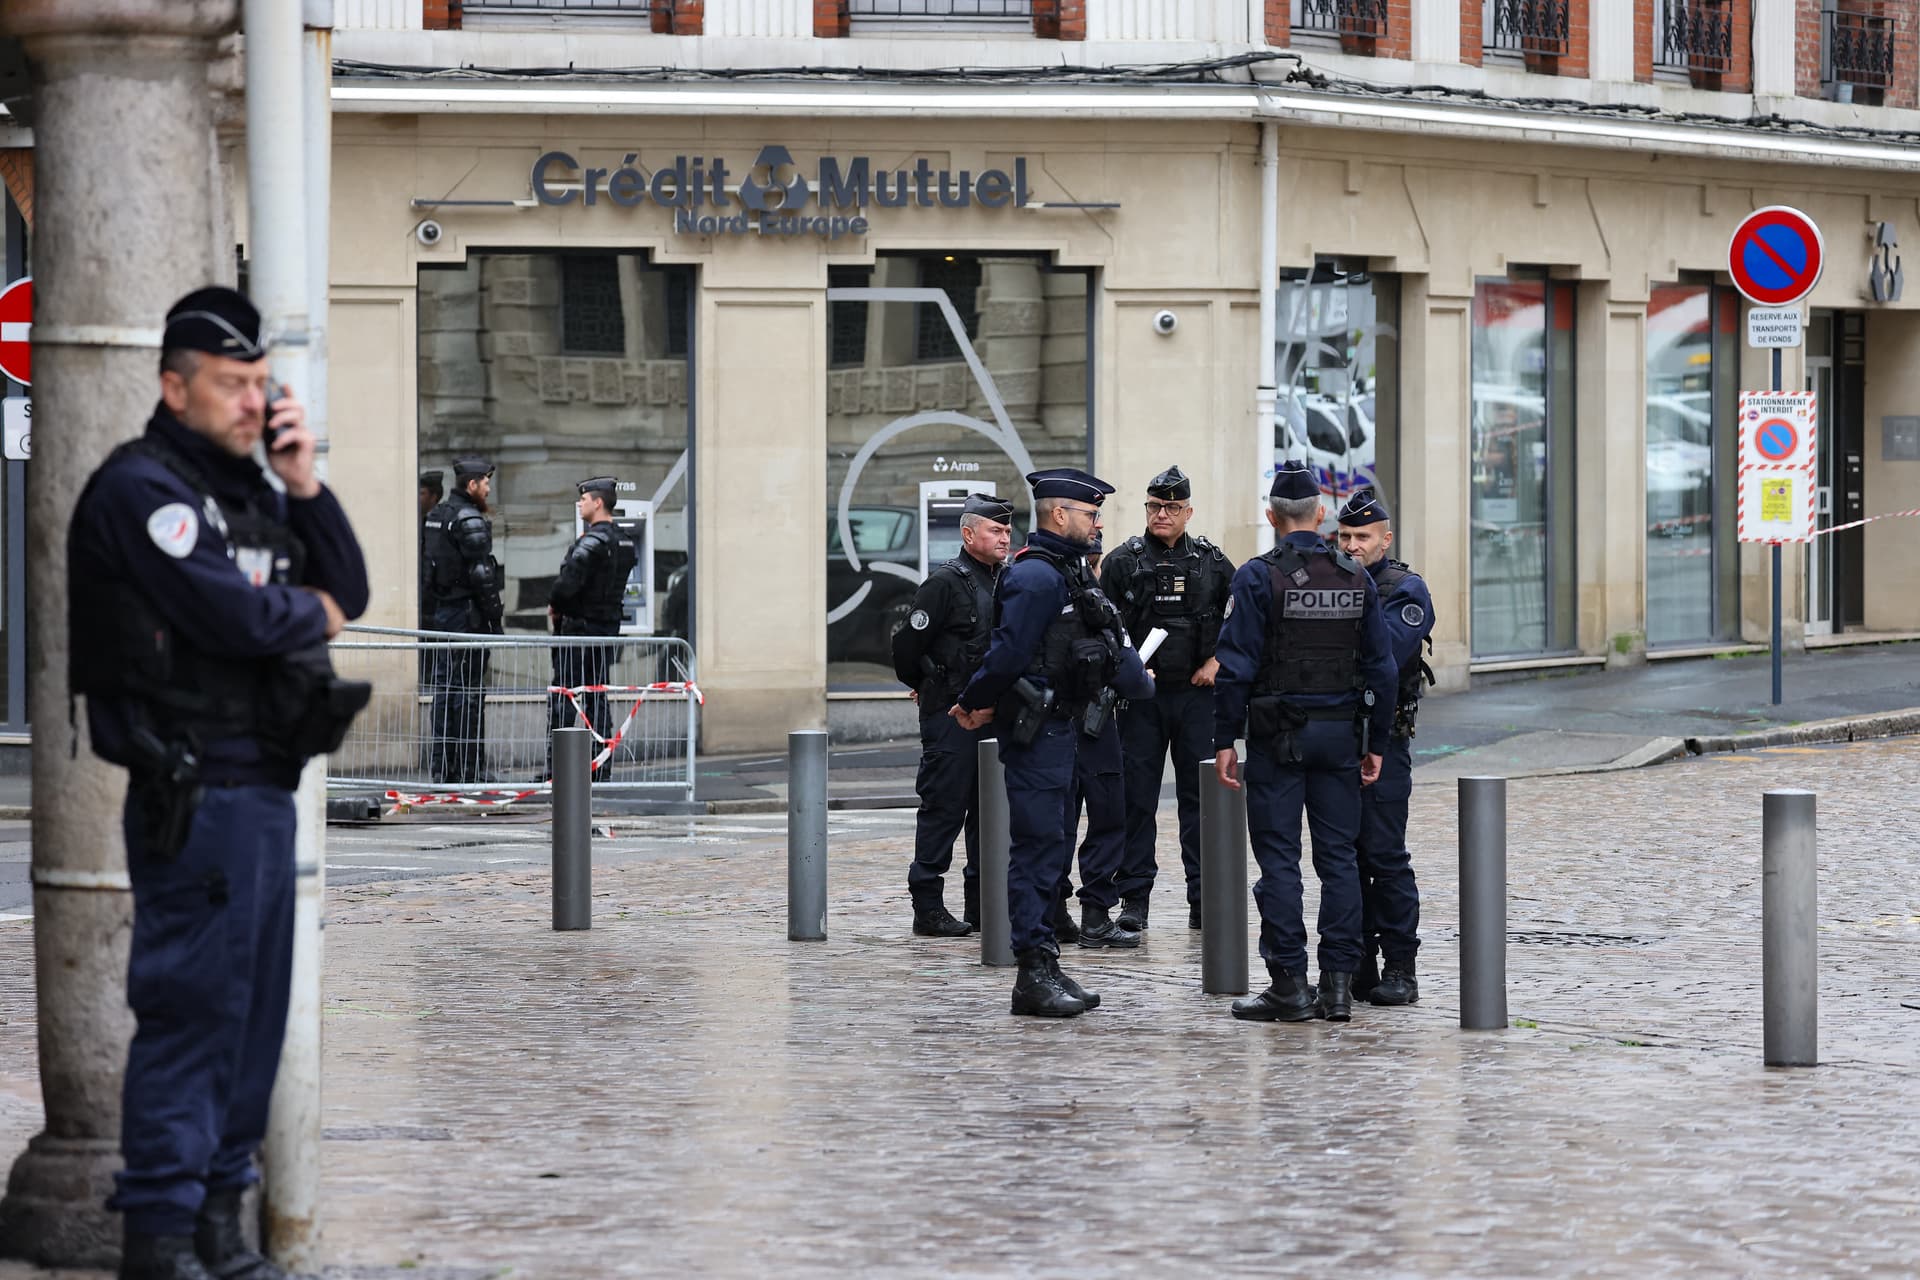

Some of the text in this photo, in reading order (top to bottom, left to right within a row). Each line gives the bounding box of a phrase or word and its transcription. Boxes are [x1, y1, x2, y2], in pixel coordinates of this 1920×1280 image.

[532, 151, 1027, 208] Crédit Mutuel
[675, 206, 869, 240] Nord Europe
[1783, 312, 1798, 321] AUX
[1752, 324, 1798, 333] TRANSPORTS
[1757, 335, 1793, 344] DE FONDS
[1747, 397, 1807, 407] STATIONNEMENT
[1760, 405, 1794, 415] INTERDIT
[950, 459, 980, 472] Arras
[614, 480, 637, 491] rras
[1286, 591, 1364, 608] POLICE
